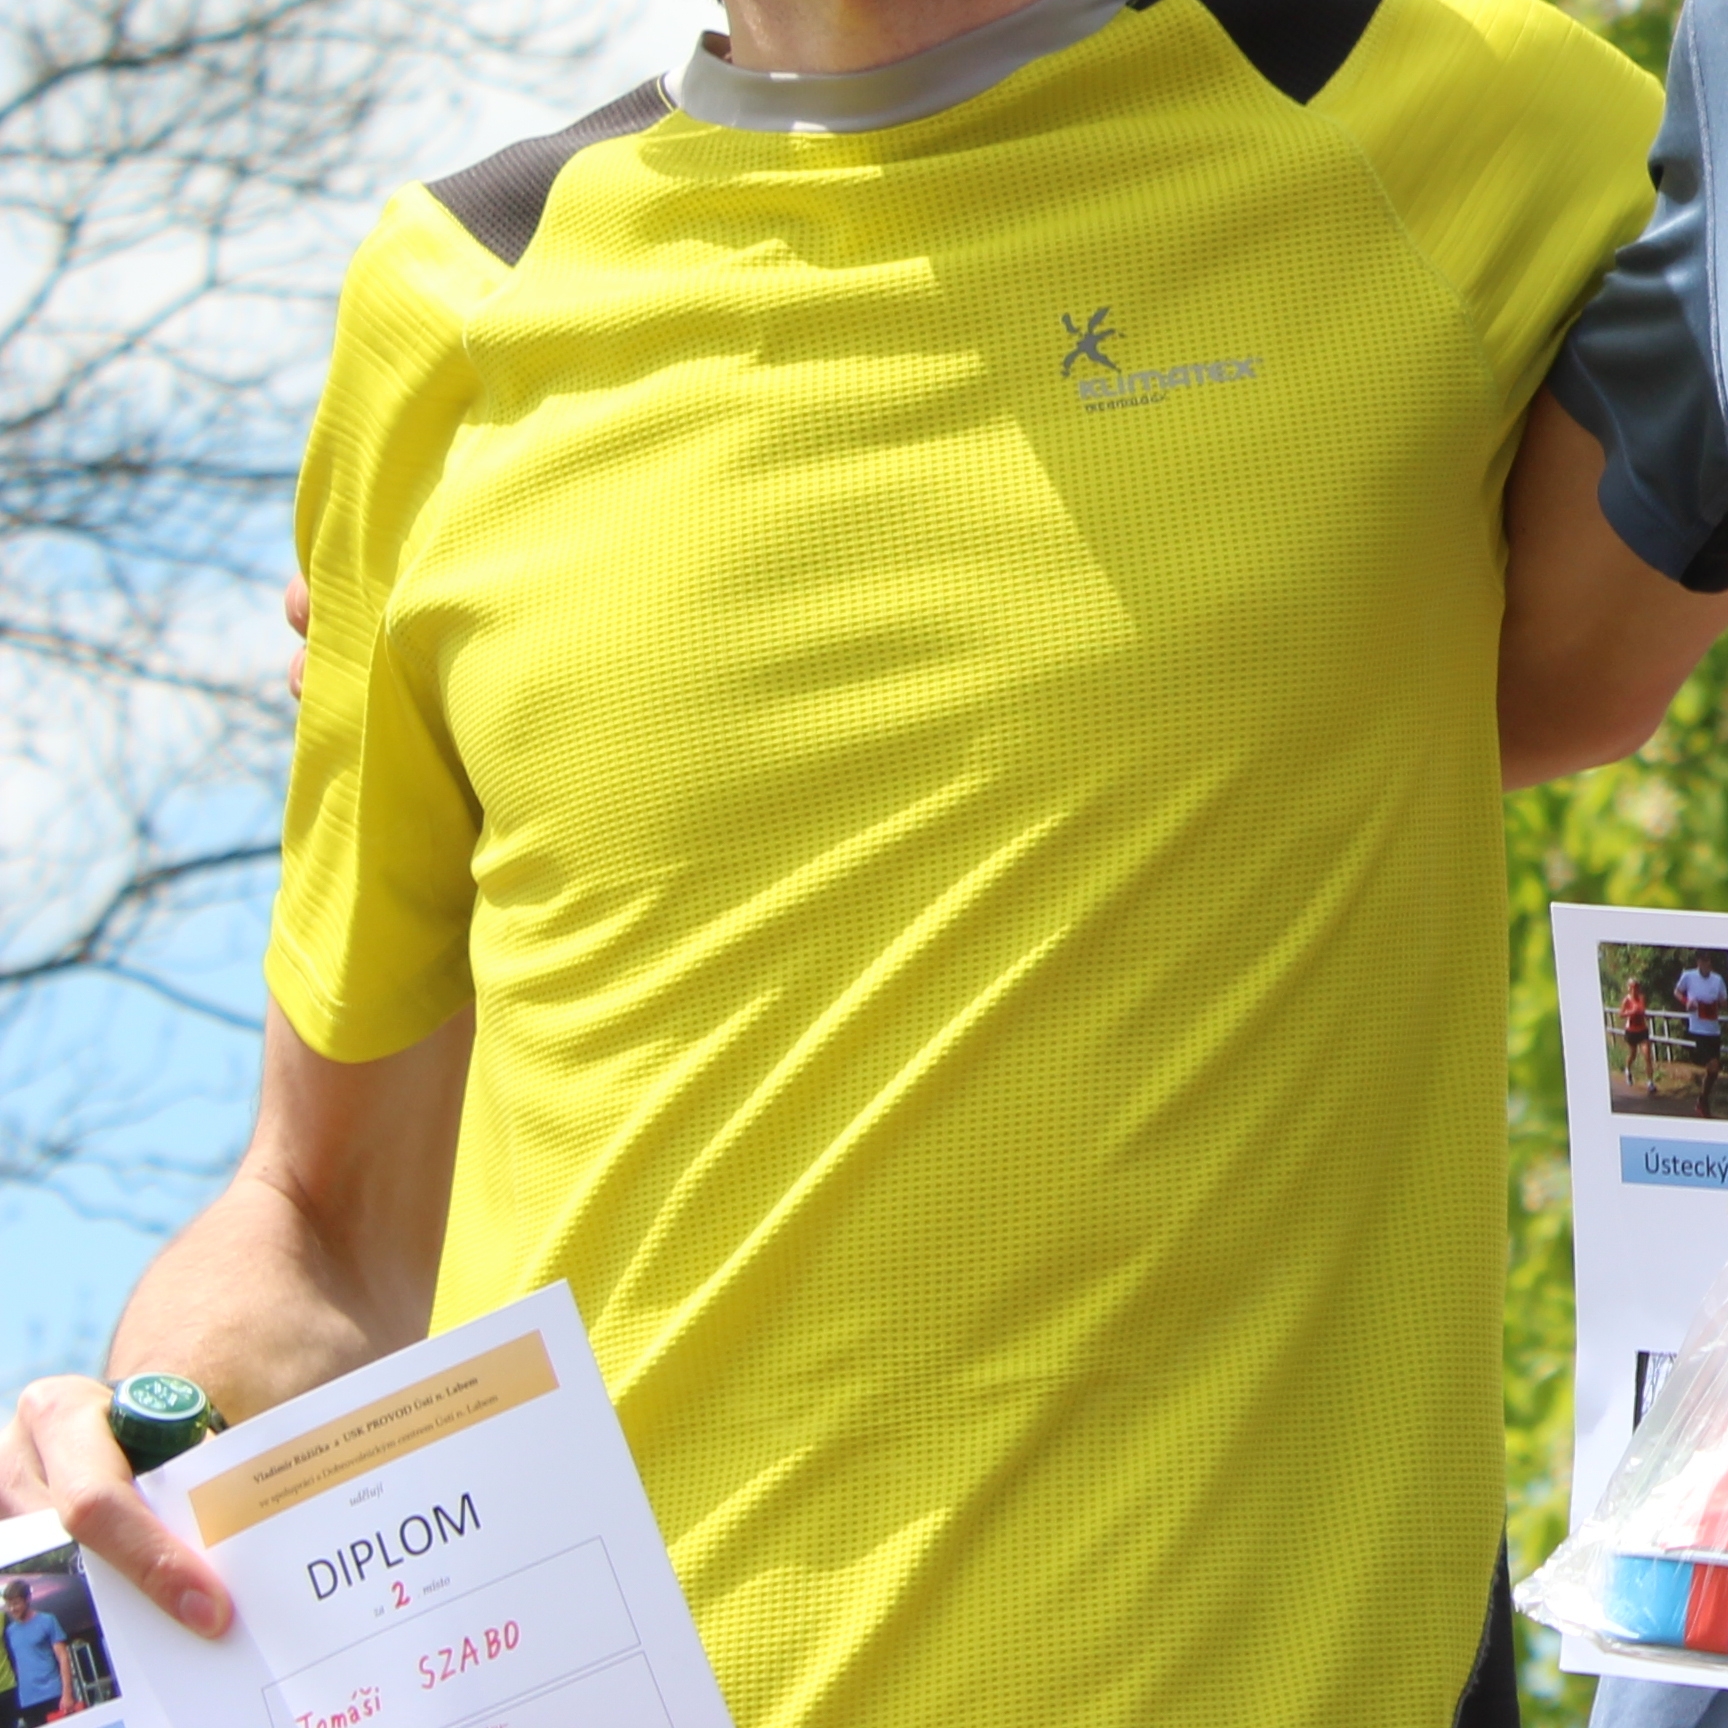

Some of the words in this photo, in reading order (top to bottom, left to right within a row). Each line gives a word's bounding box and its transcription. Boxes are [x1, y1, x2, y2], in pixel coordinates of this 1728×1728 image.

[343, 1425, 367, 1445] USK
[366, 1404, 413, 1434] PROVOD
[446, 1376, 479, 1399] Labem
[466, 1393, 500, 1418] Labem
[305, 1492, 482, 1602] DIPLOM
[390, 1580, 412, 1610] 2
[295, 1686, 382, 1728] Tomáši
[417, 1619, 520, 1691] SZABO
